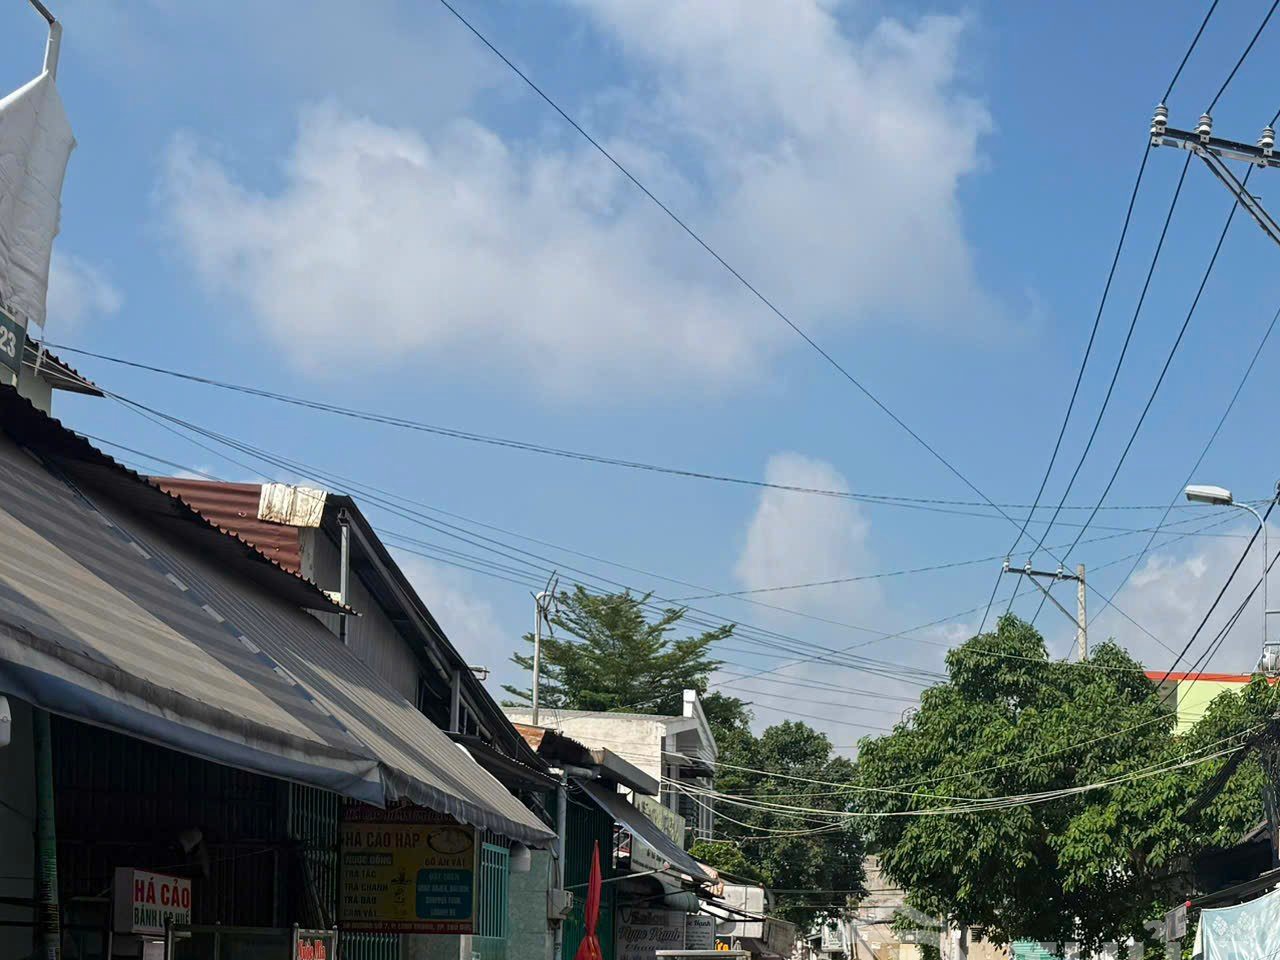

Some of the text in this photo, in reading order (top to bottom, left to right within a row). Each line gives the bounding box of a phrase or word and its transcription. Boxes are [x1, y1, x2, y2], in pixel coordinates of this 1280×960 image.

[134, 877, 190, 908] HÁ CẢO
[134, 904, 157, 928] BÁNH
